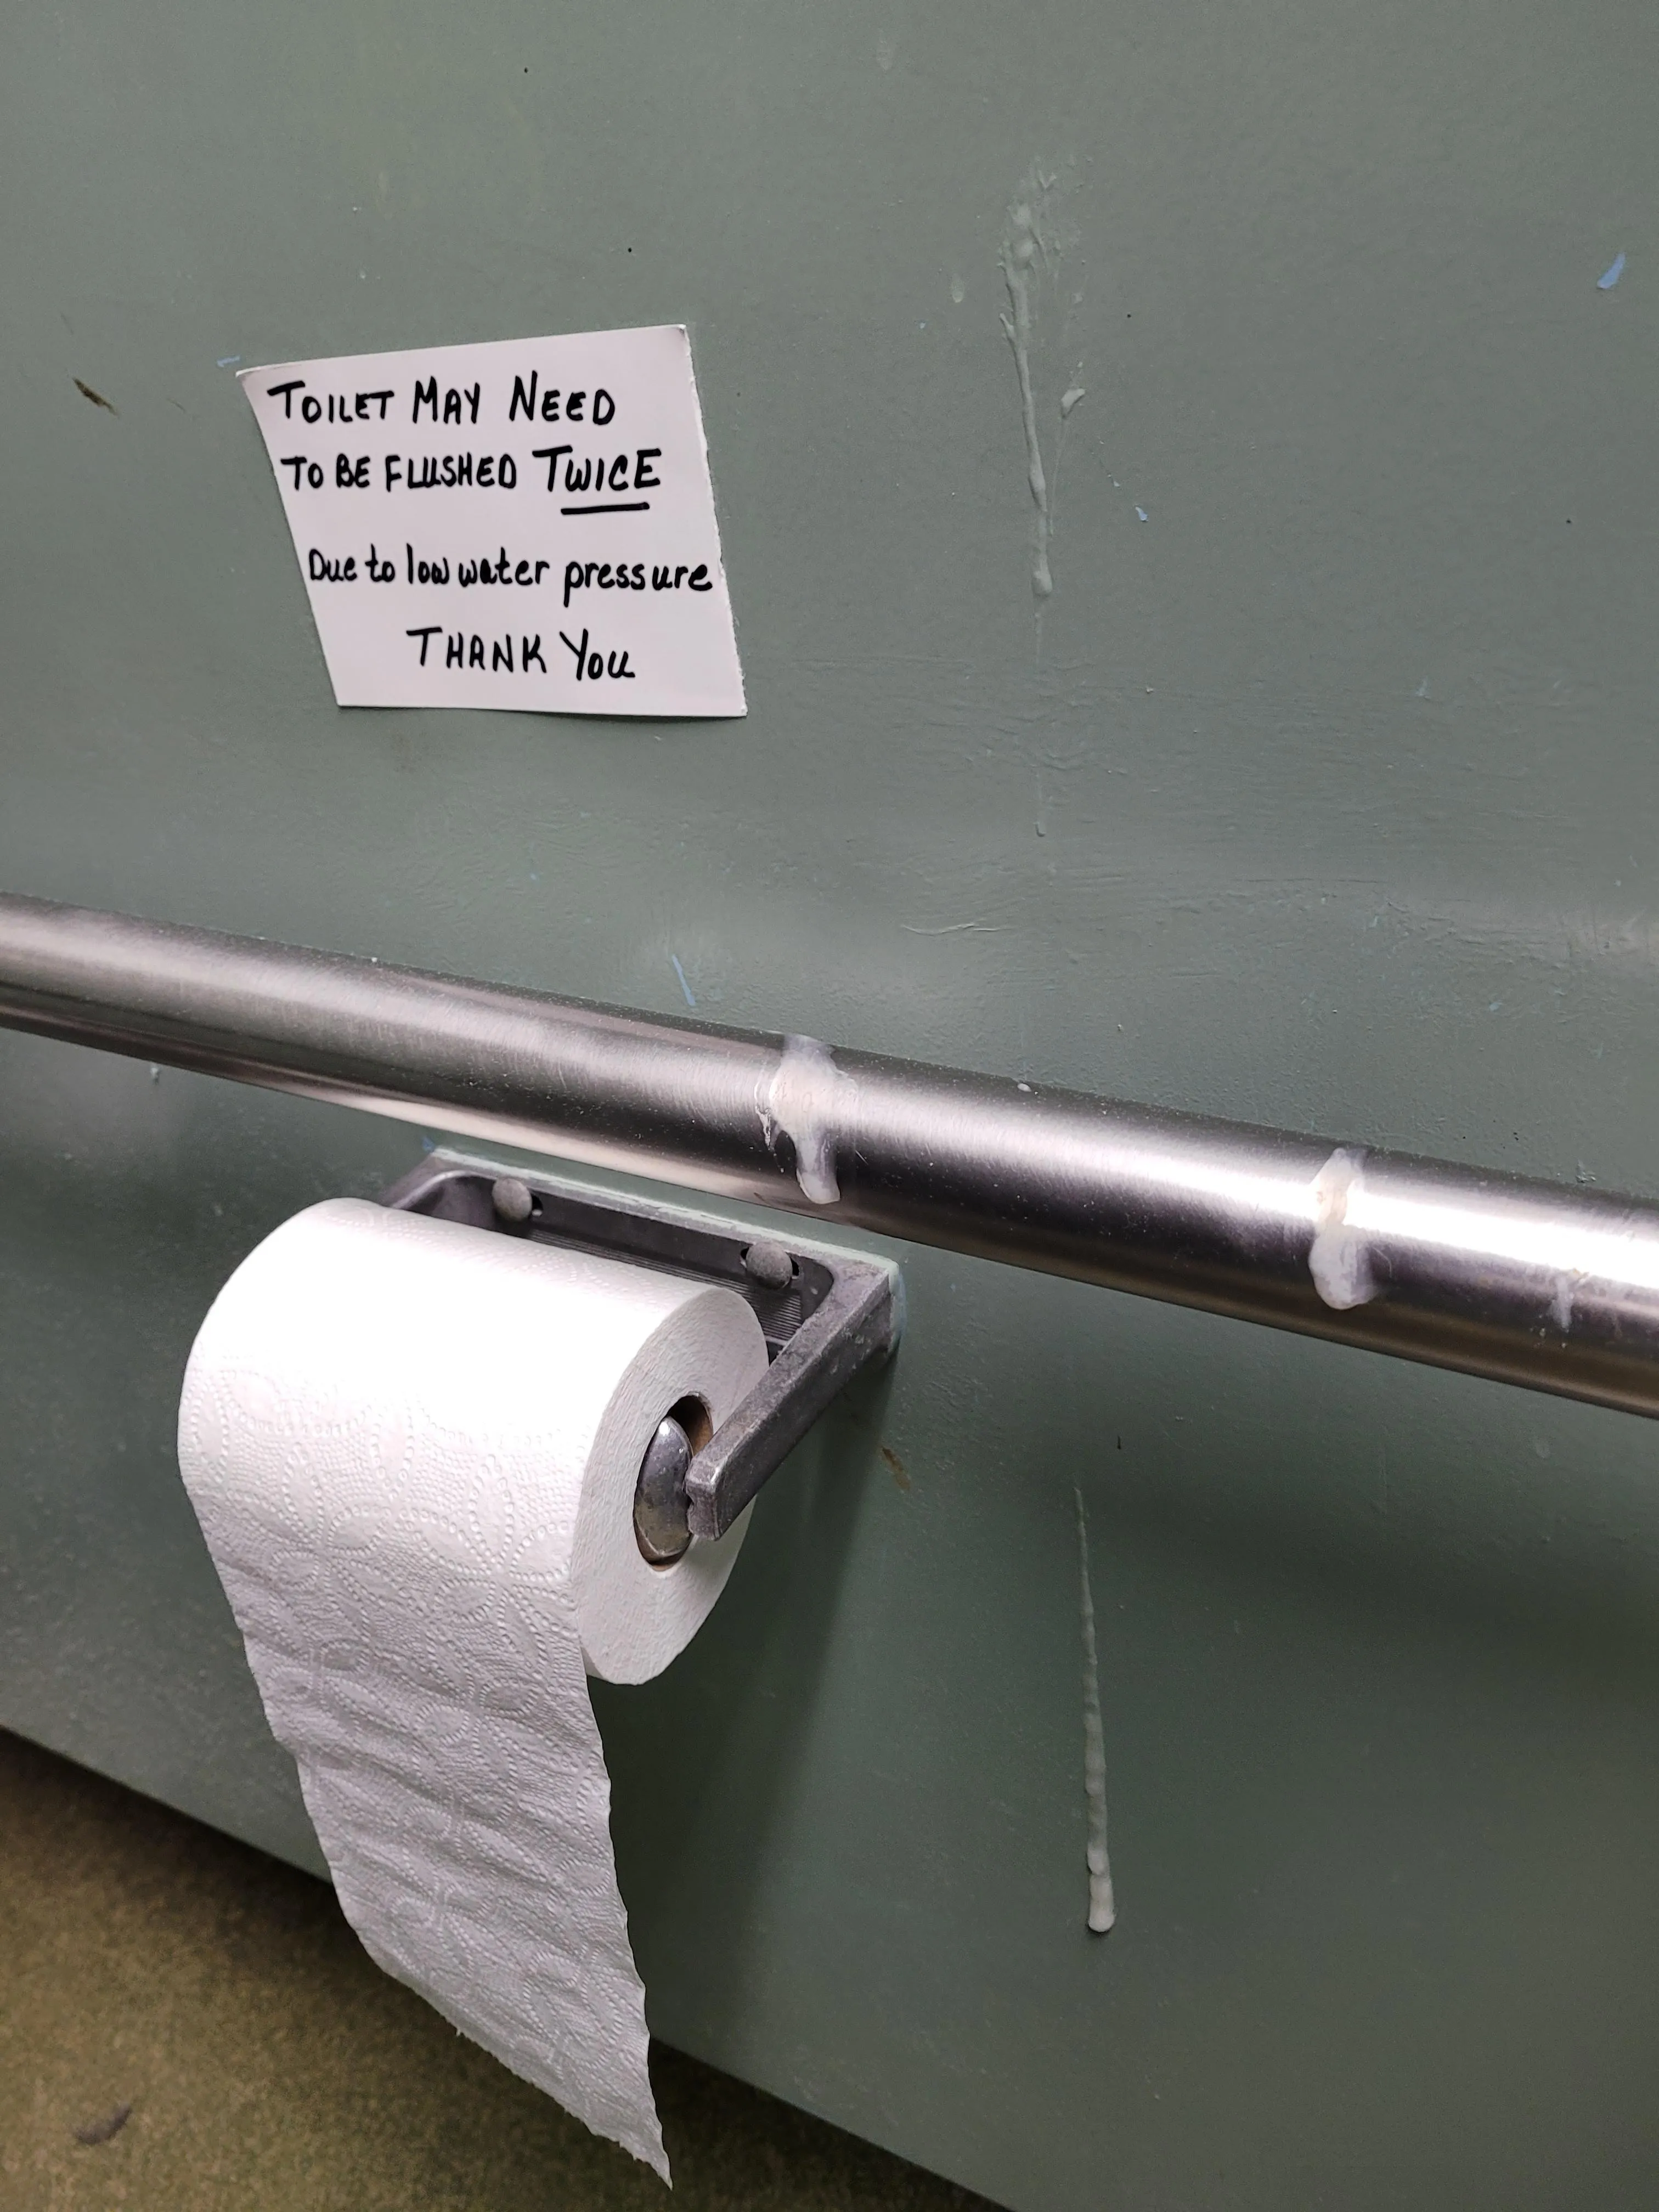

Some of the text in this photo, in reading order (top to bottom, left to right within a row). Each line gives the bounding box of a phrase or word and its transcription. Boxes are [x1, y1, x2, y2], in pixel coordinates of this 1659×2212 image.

[267, 369, 616, 426] TOILET MAY NEED
[280, 444, 662, 493] TO BE FLUSHED TWICE
[308, 543, 714, 607] Due to low water pressure
[405, 626, 548, 674] THANK
